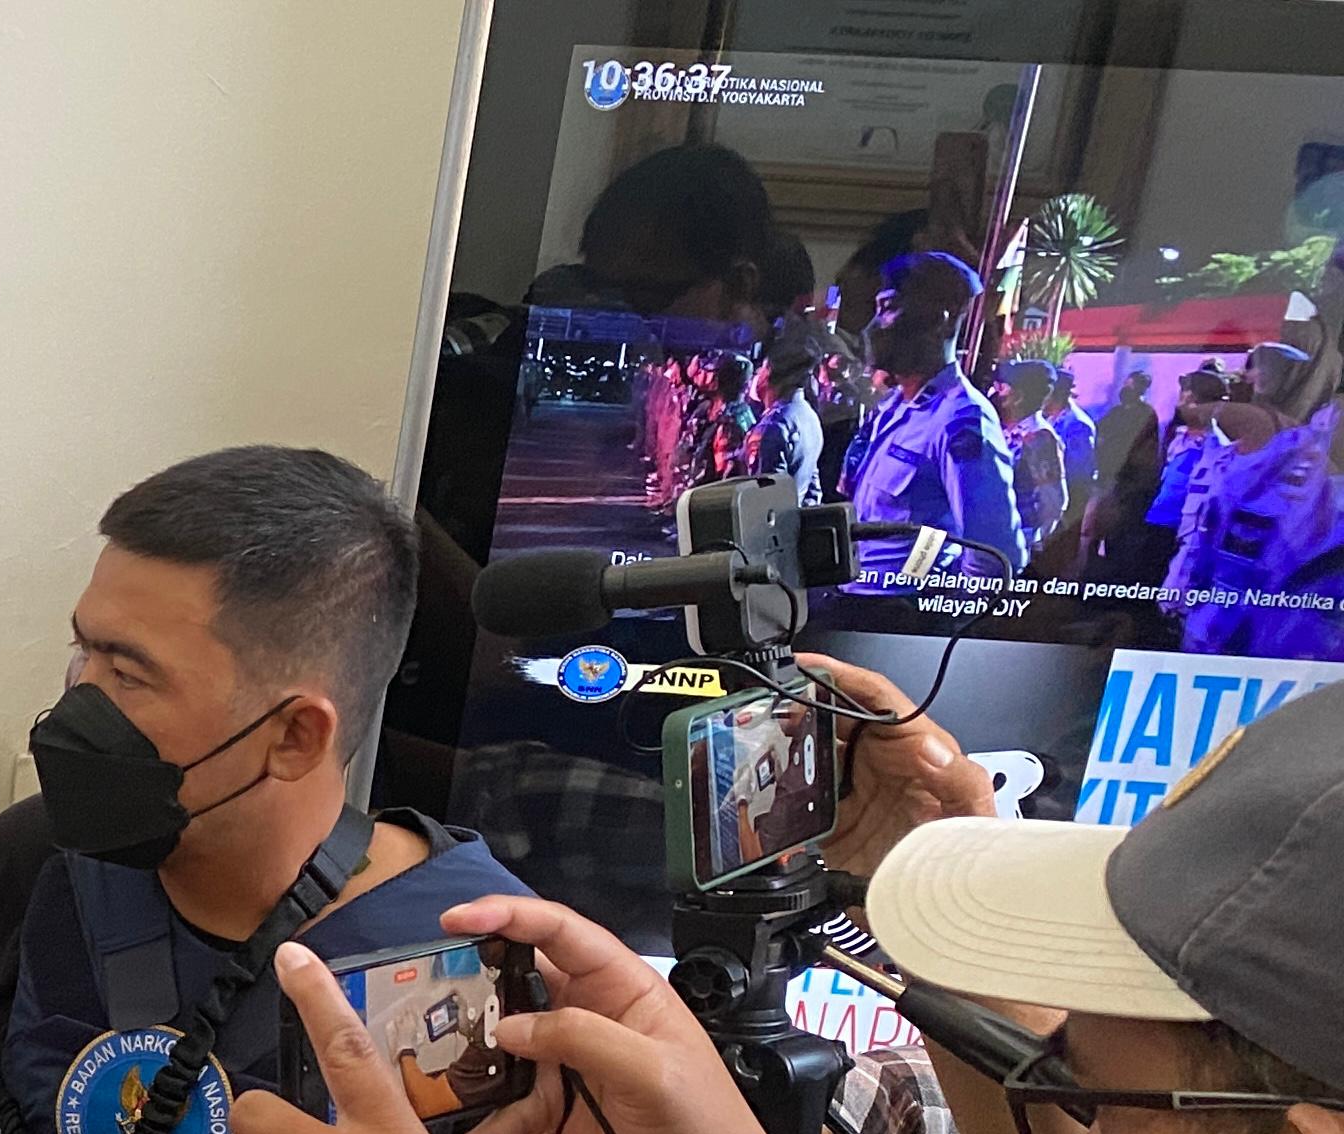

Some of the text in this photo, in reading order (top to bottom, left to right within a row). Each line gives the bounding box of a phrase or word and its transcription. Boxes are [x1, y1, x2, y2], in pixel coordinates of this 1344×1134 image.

[582, 60, 732, 95] 10:36:37
[760, 78, 825, 94] NASIONAL
[720, 92, 805, 106] YOGYAKARTA
[1042, 577, 1079, 596] dan
[1083, 582, 1180, 601] peredaran
[1185, 586, 1239, 609] gelap
[1243, 588, 1334, 611] Narkotika
[71, 1042, 117, 1095] BADAN
